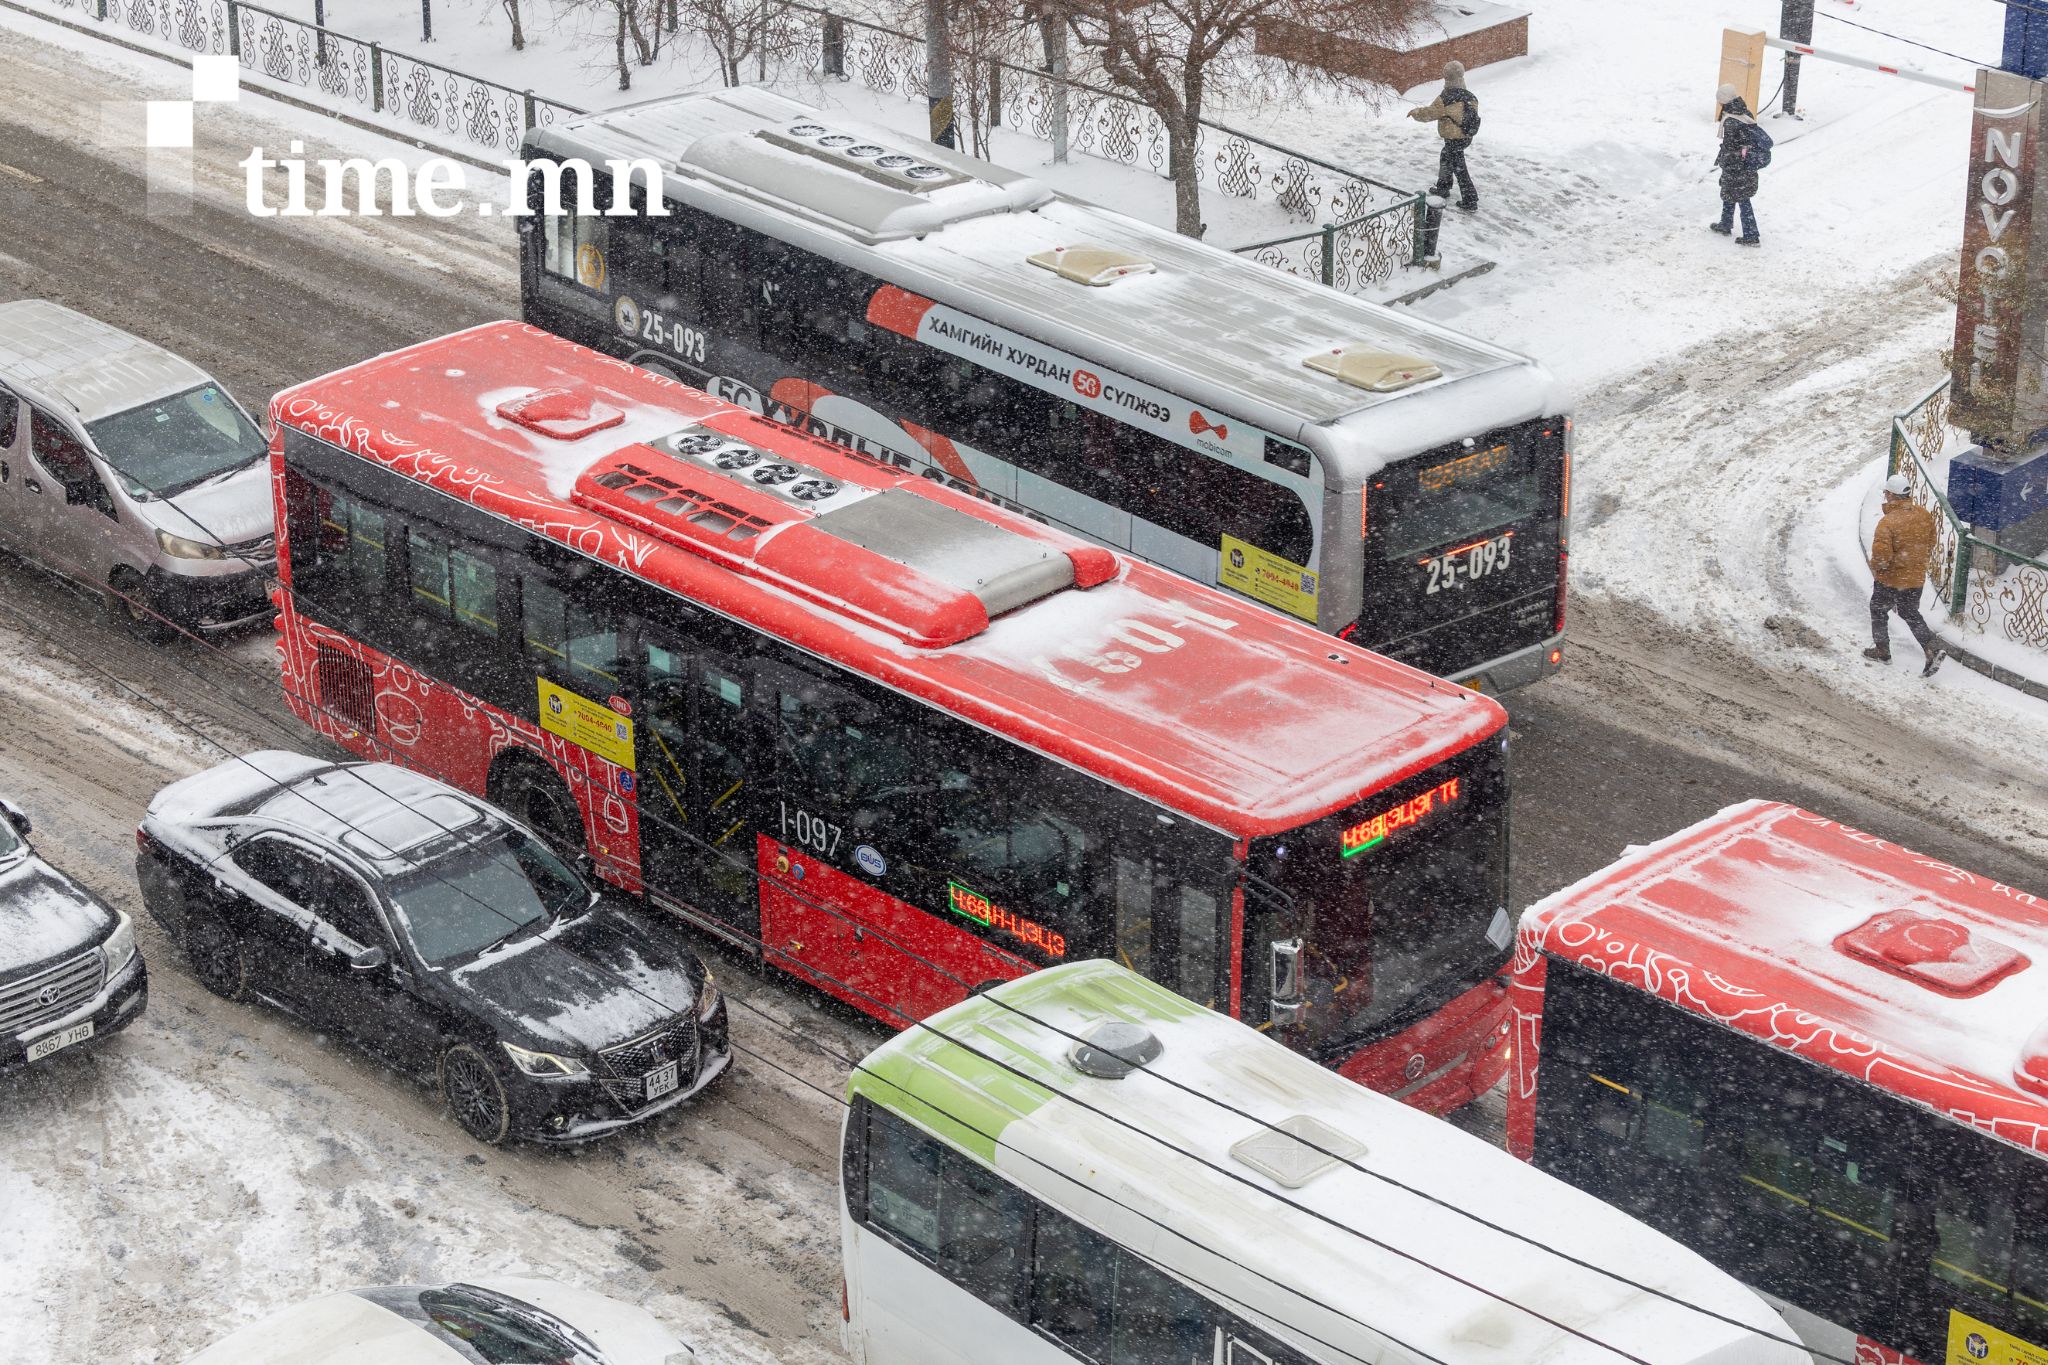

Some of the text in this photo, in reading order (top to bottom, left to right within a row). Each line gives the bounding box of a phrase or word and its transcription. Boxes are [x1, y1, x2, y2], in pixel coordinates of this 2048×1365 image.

[642, 309, 706, 363] 25-093
[929, 316, 1171, 423] ХАМГИЙН ХУРДАН 5G СҮЛЖЭЭ
[1196, 438, 1233, 459] mobicom
[1426, 537, 1511, 595] 25-093
[780, 800, 841, 857] 1-097
[35, 1036, 62, 1057] 8867
[663, 1067, 675, 1082] 37
